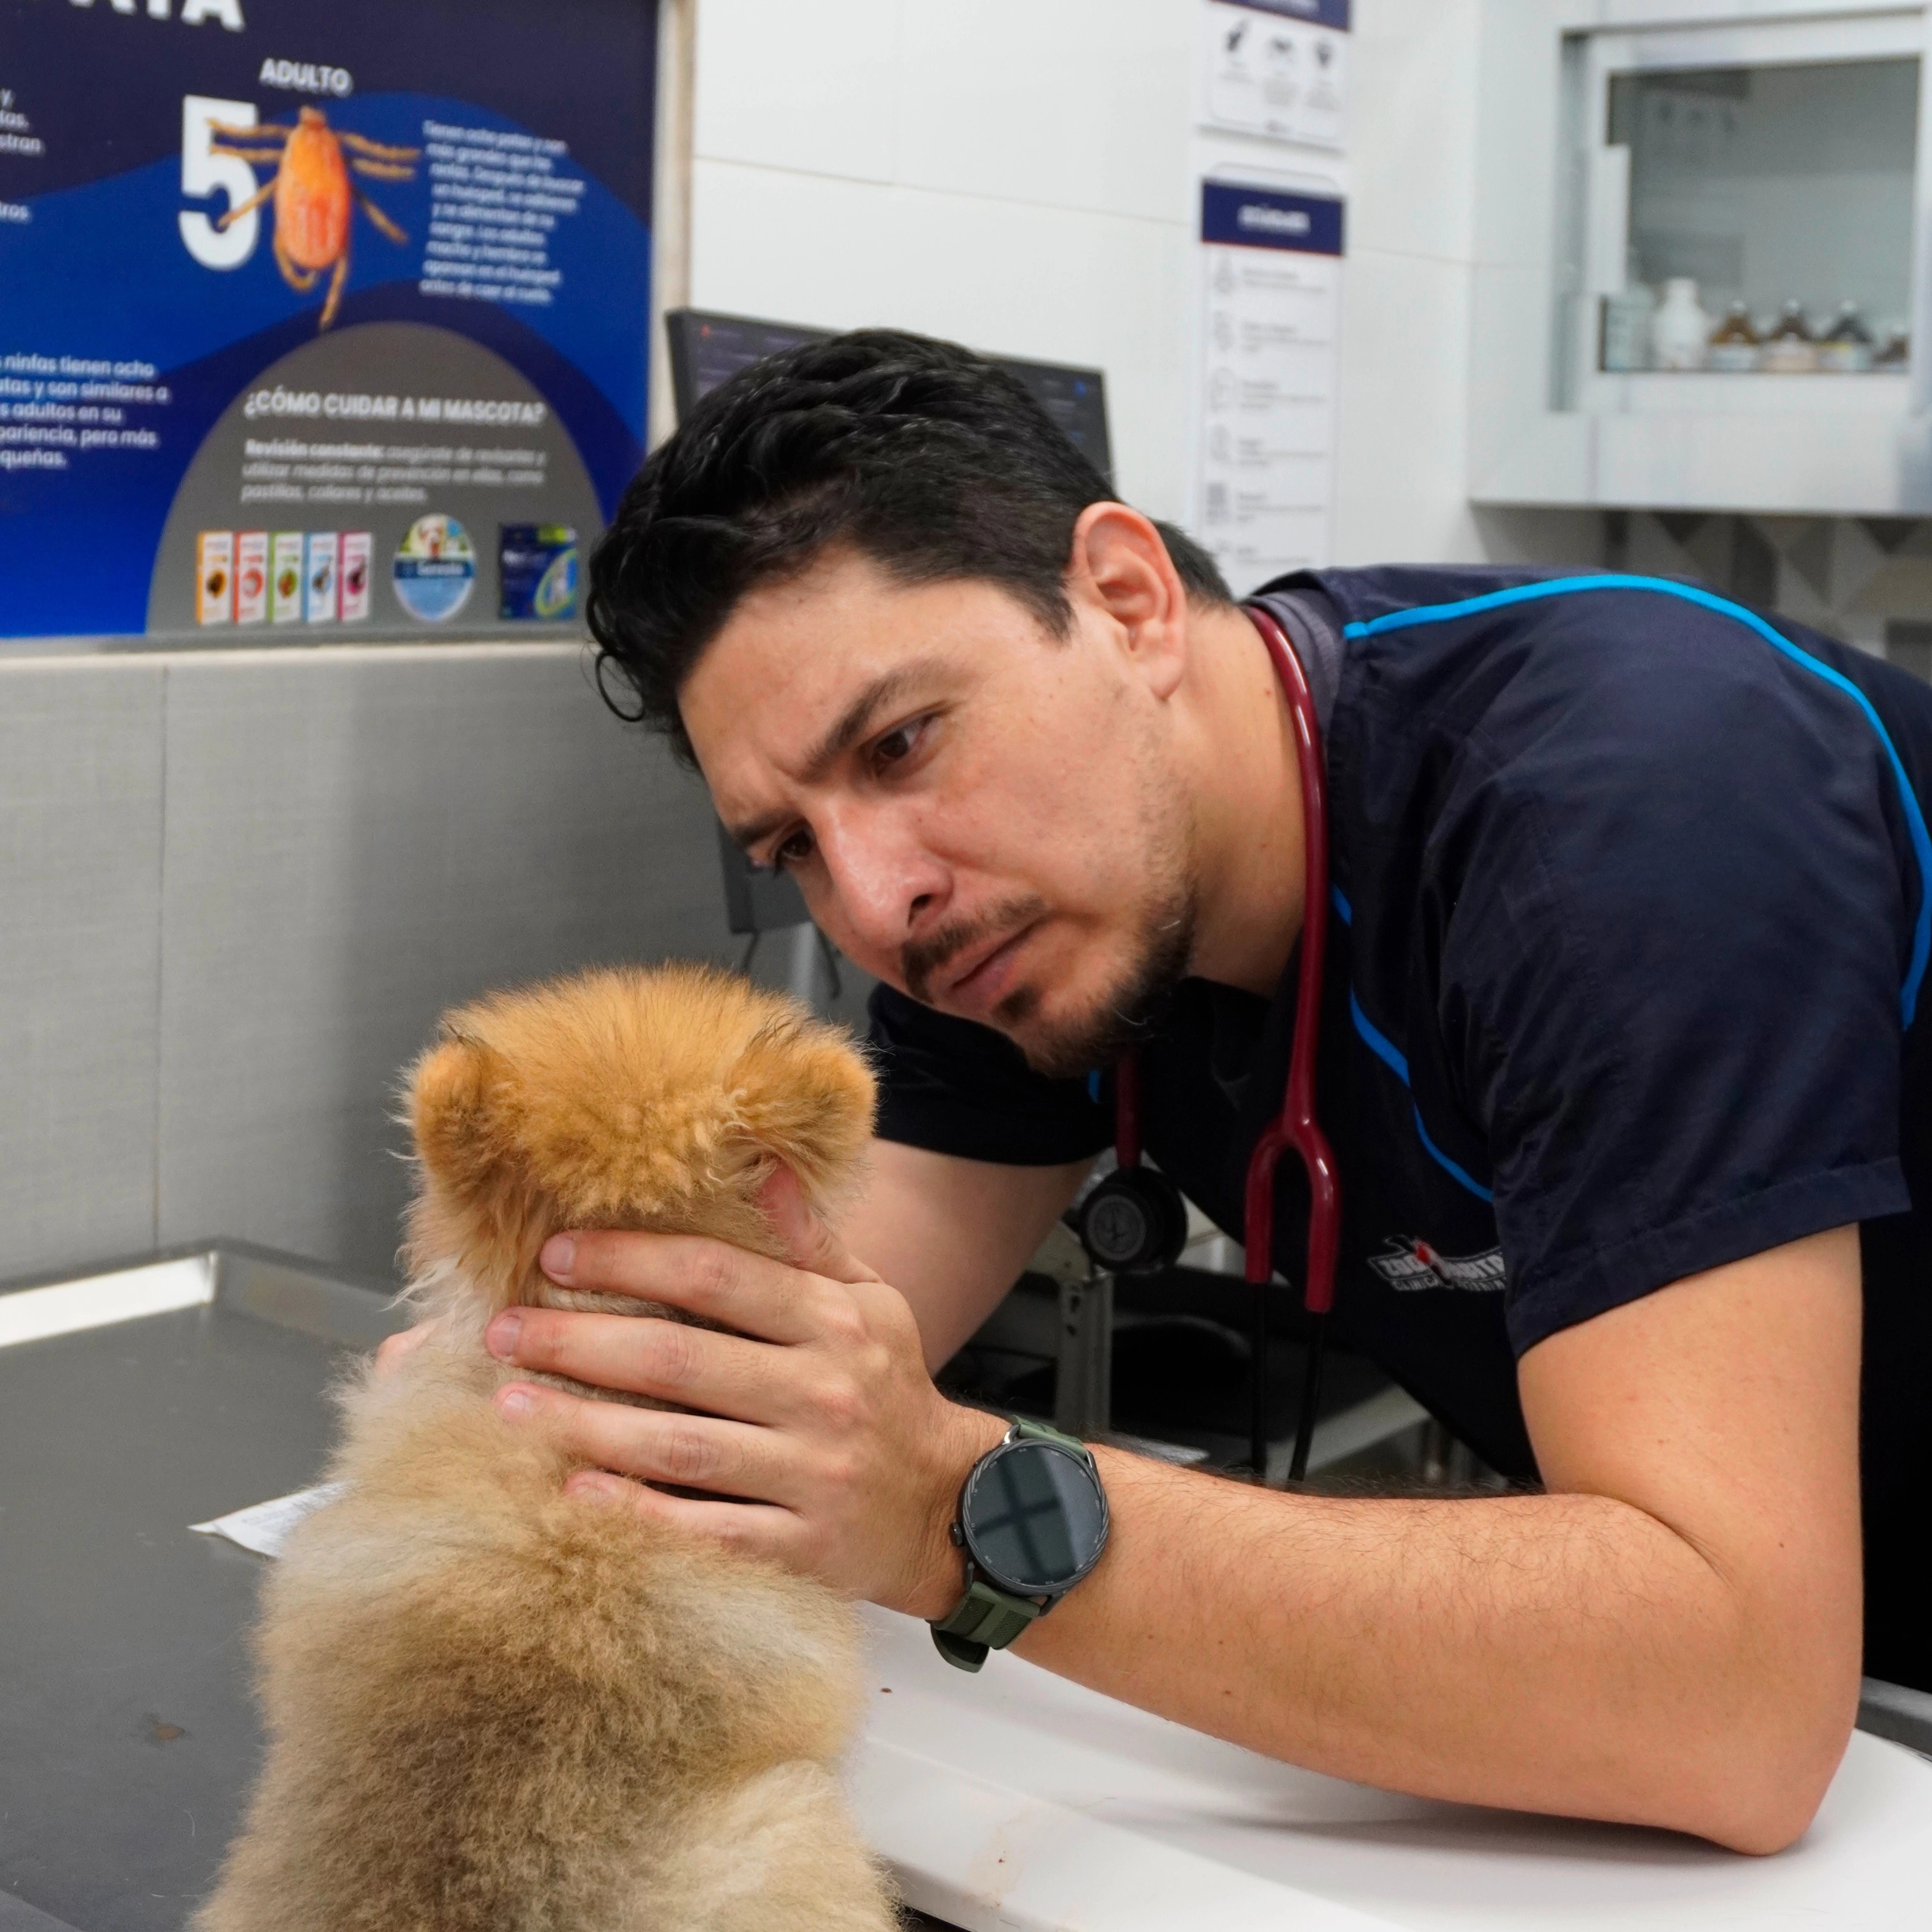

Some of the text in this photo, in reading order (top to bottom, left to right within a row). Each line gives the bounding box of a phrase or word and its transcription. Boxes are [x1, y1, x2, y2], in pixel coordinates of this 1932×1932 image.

[260, 57, 354, 98] ADULTO
[179, 95, 258, 270] 5
[5, 352, 157, 382] ninfas tienen ocho
[34, 380, 44, 401] y
[48, 381, 78, 400] son
[80, 379, 154, 405] similares
[244, 384, 547, 427] ¿CÓMO CUIDAR A MI MASCOTA?
[13, 400, 75, 423] adultos
[77, 406, 99, 424] en
[102, 406, 125, 427] su
[80, 428, 119, 451] pero
